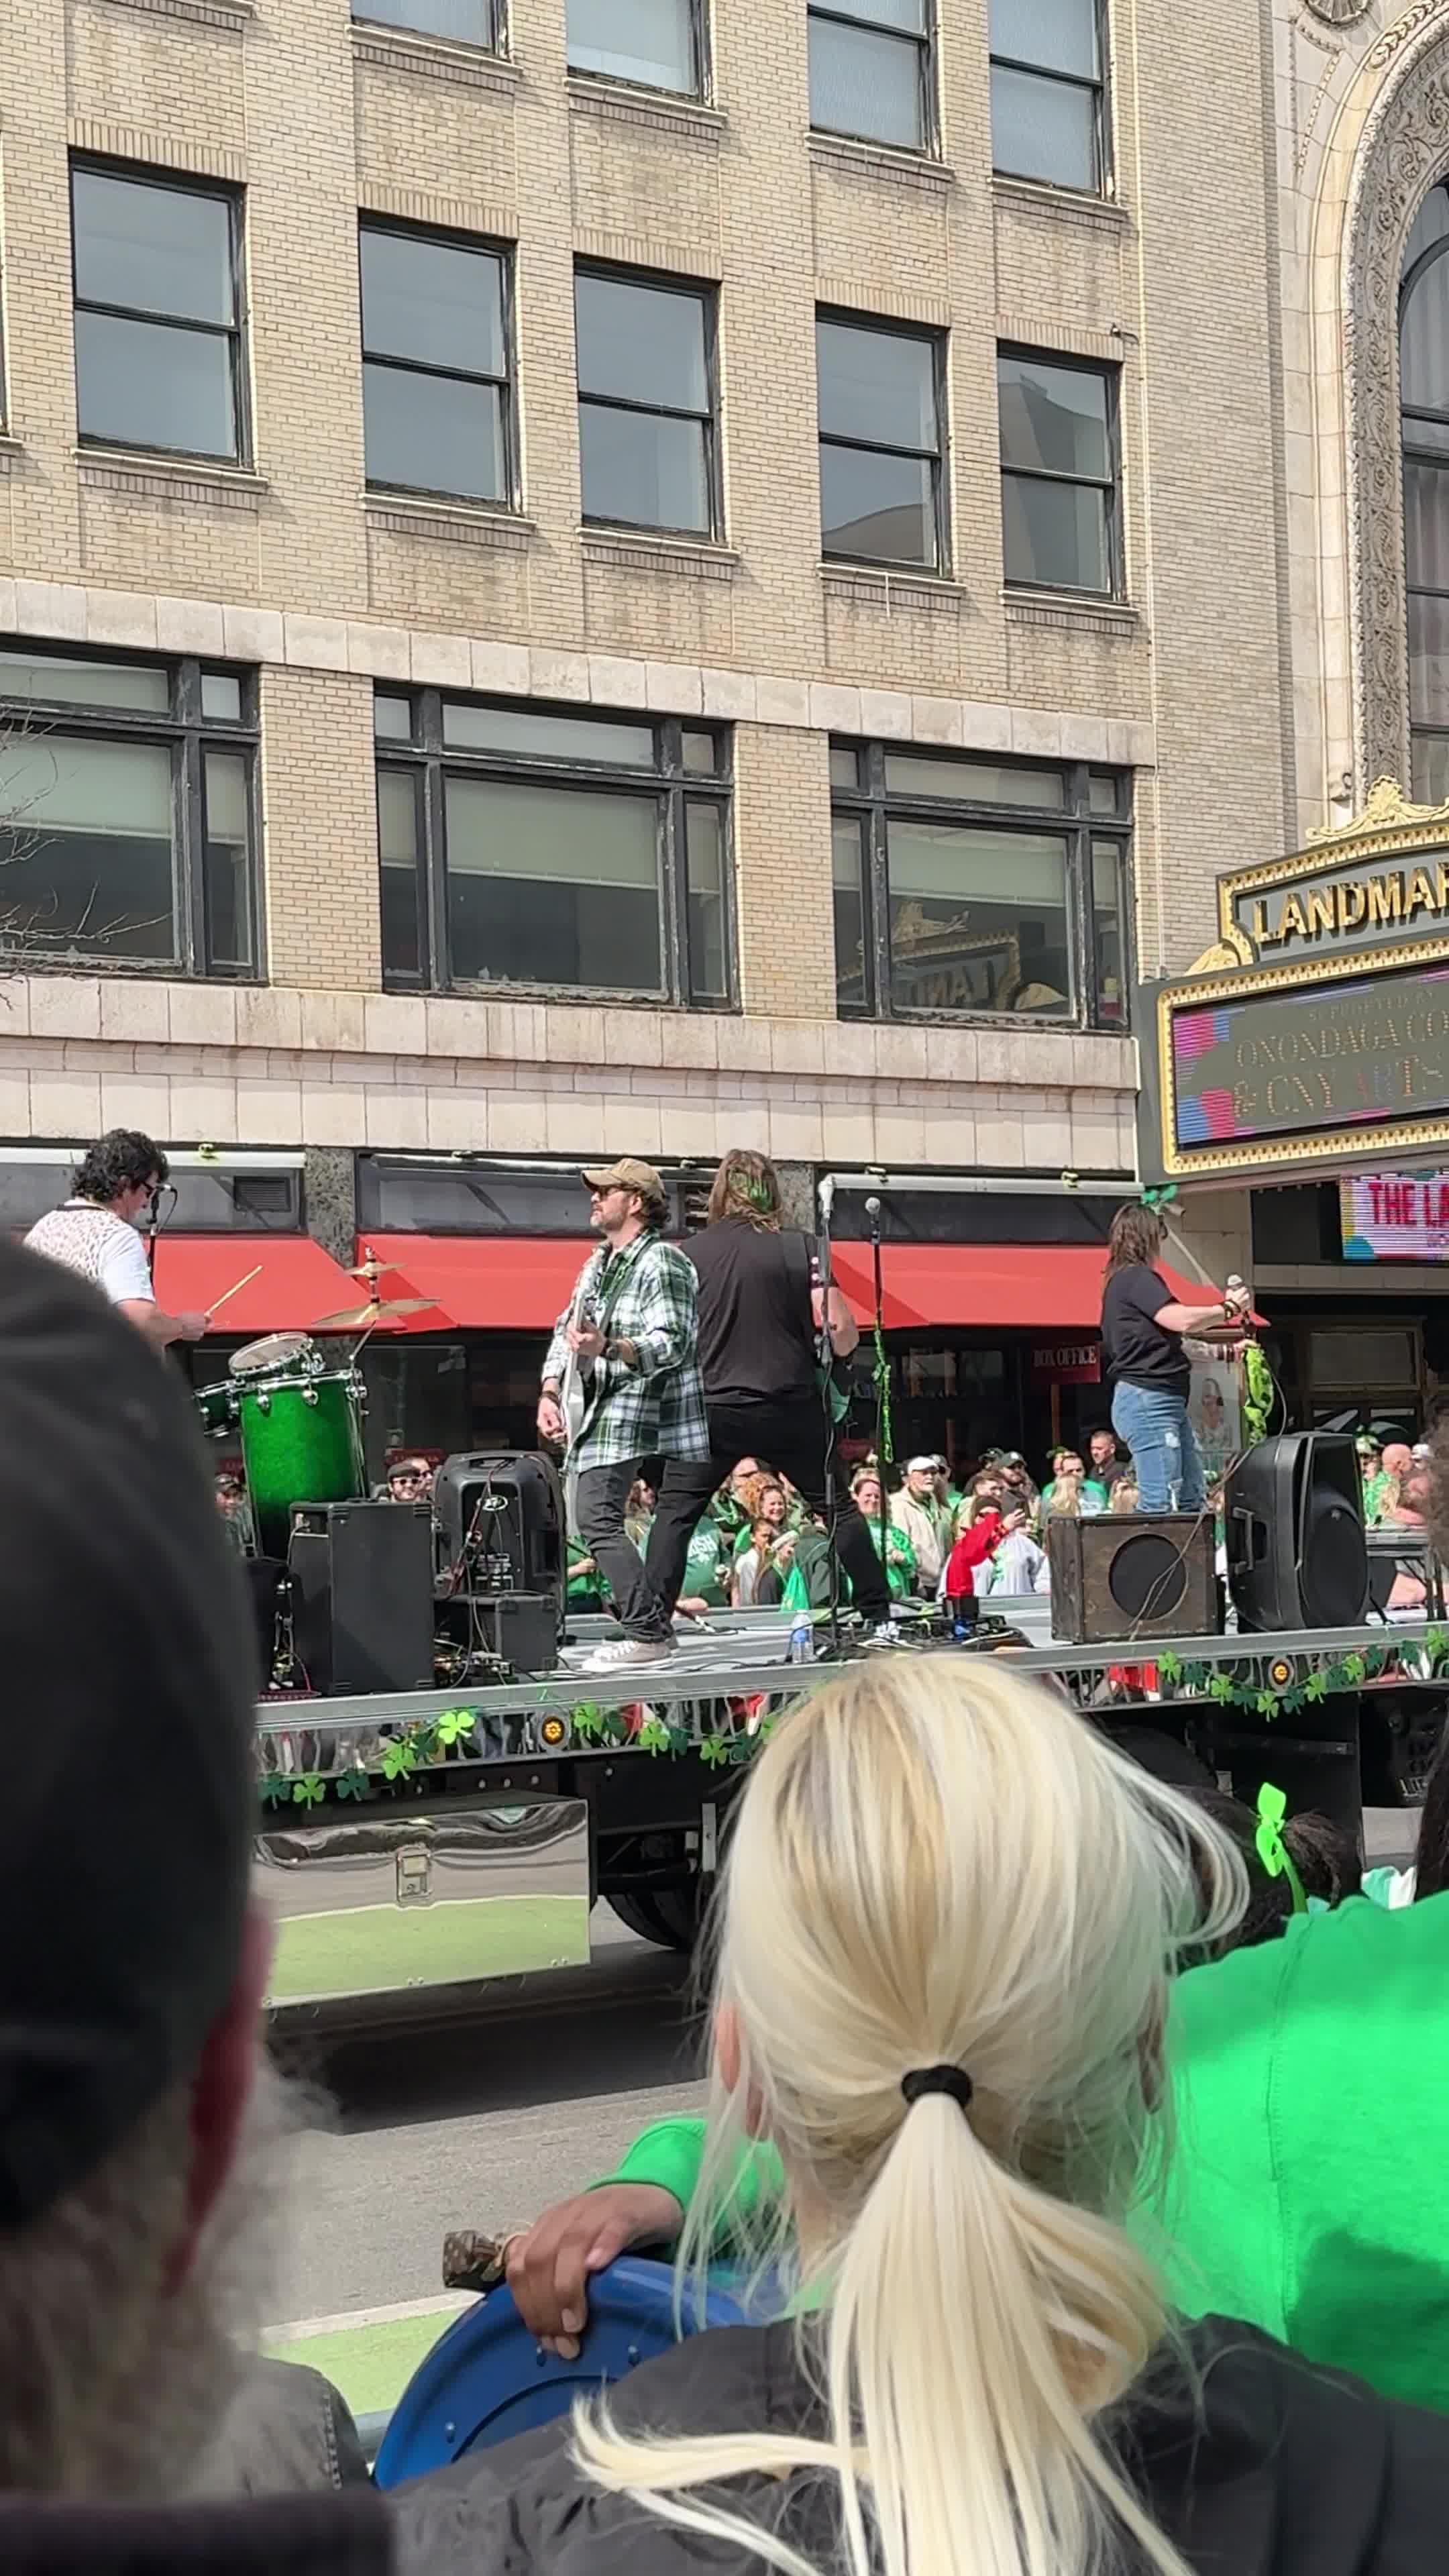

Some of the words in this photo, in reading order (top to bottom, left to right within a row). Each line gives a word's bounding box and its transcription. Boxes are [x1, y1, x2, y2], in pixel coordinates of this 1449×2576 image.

[1236, 1018, 1402, 1068] ONONDAGA
[1266, 1068, 1336, 1117] CNY
[1368, 1182, 1417, 1225] THE
[1057, 1345, 1097, 1366] OFFICE
